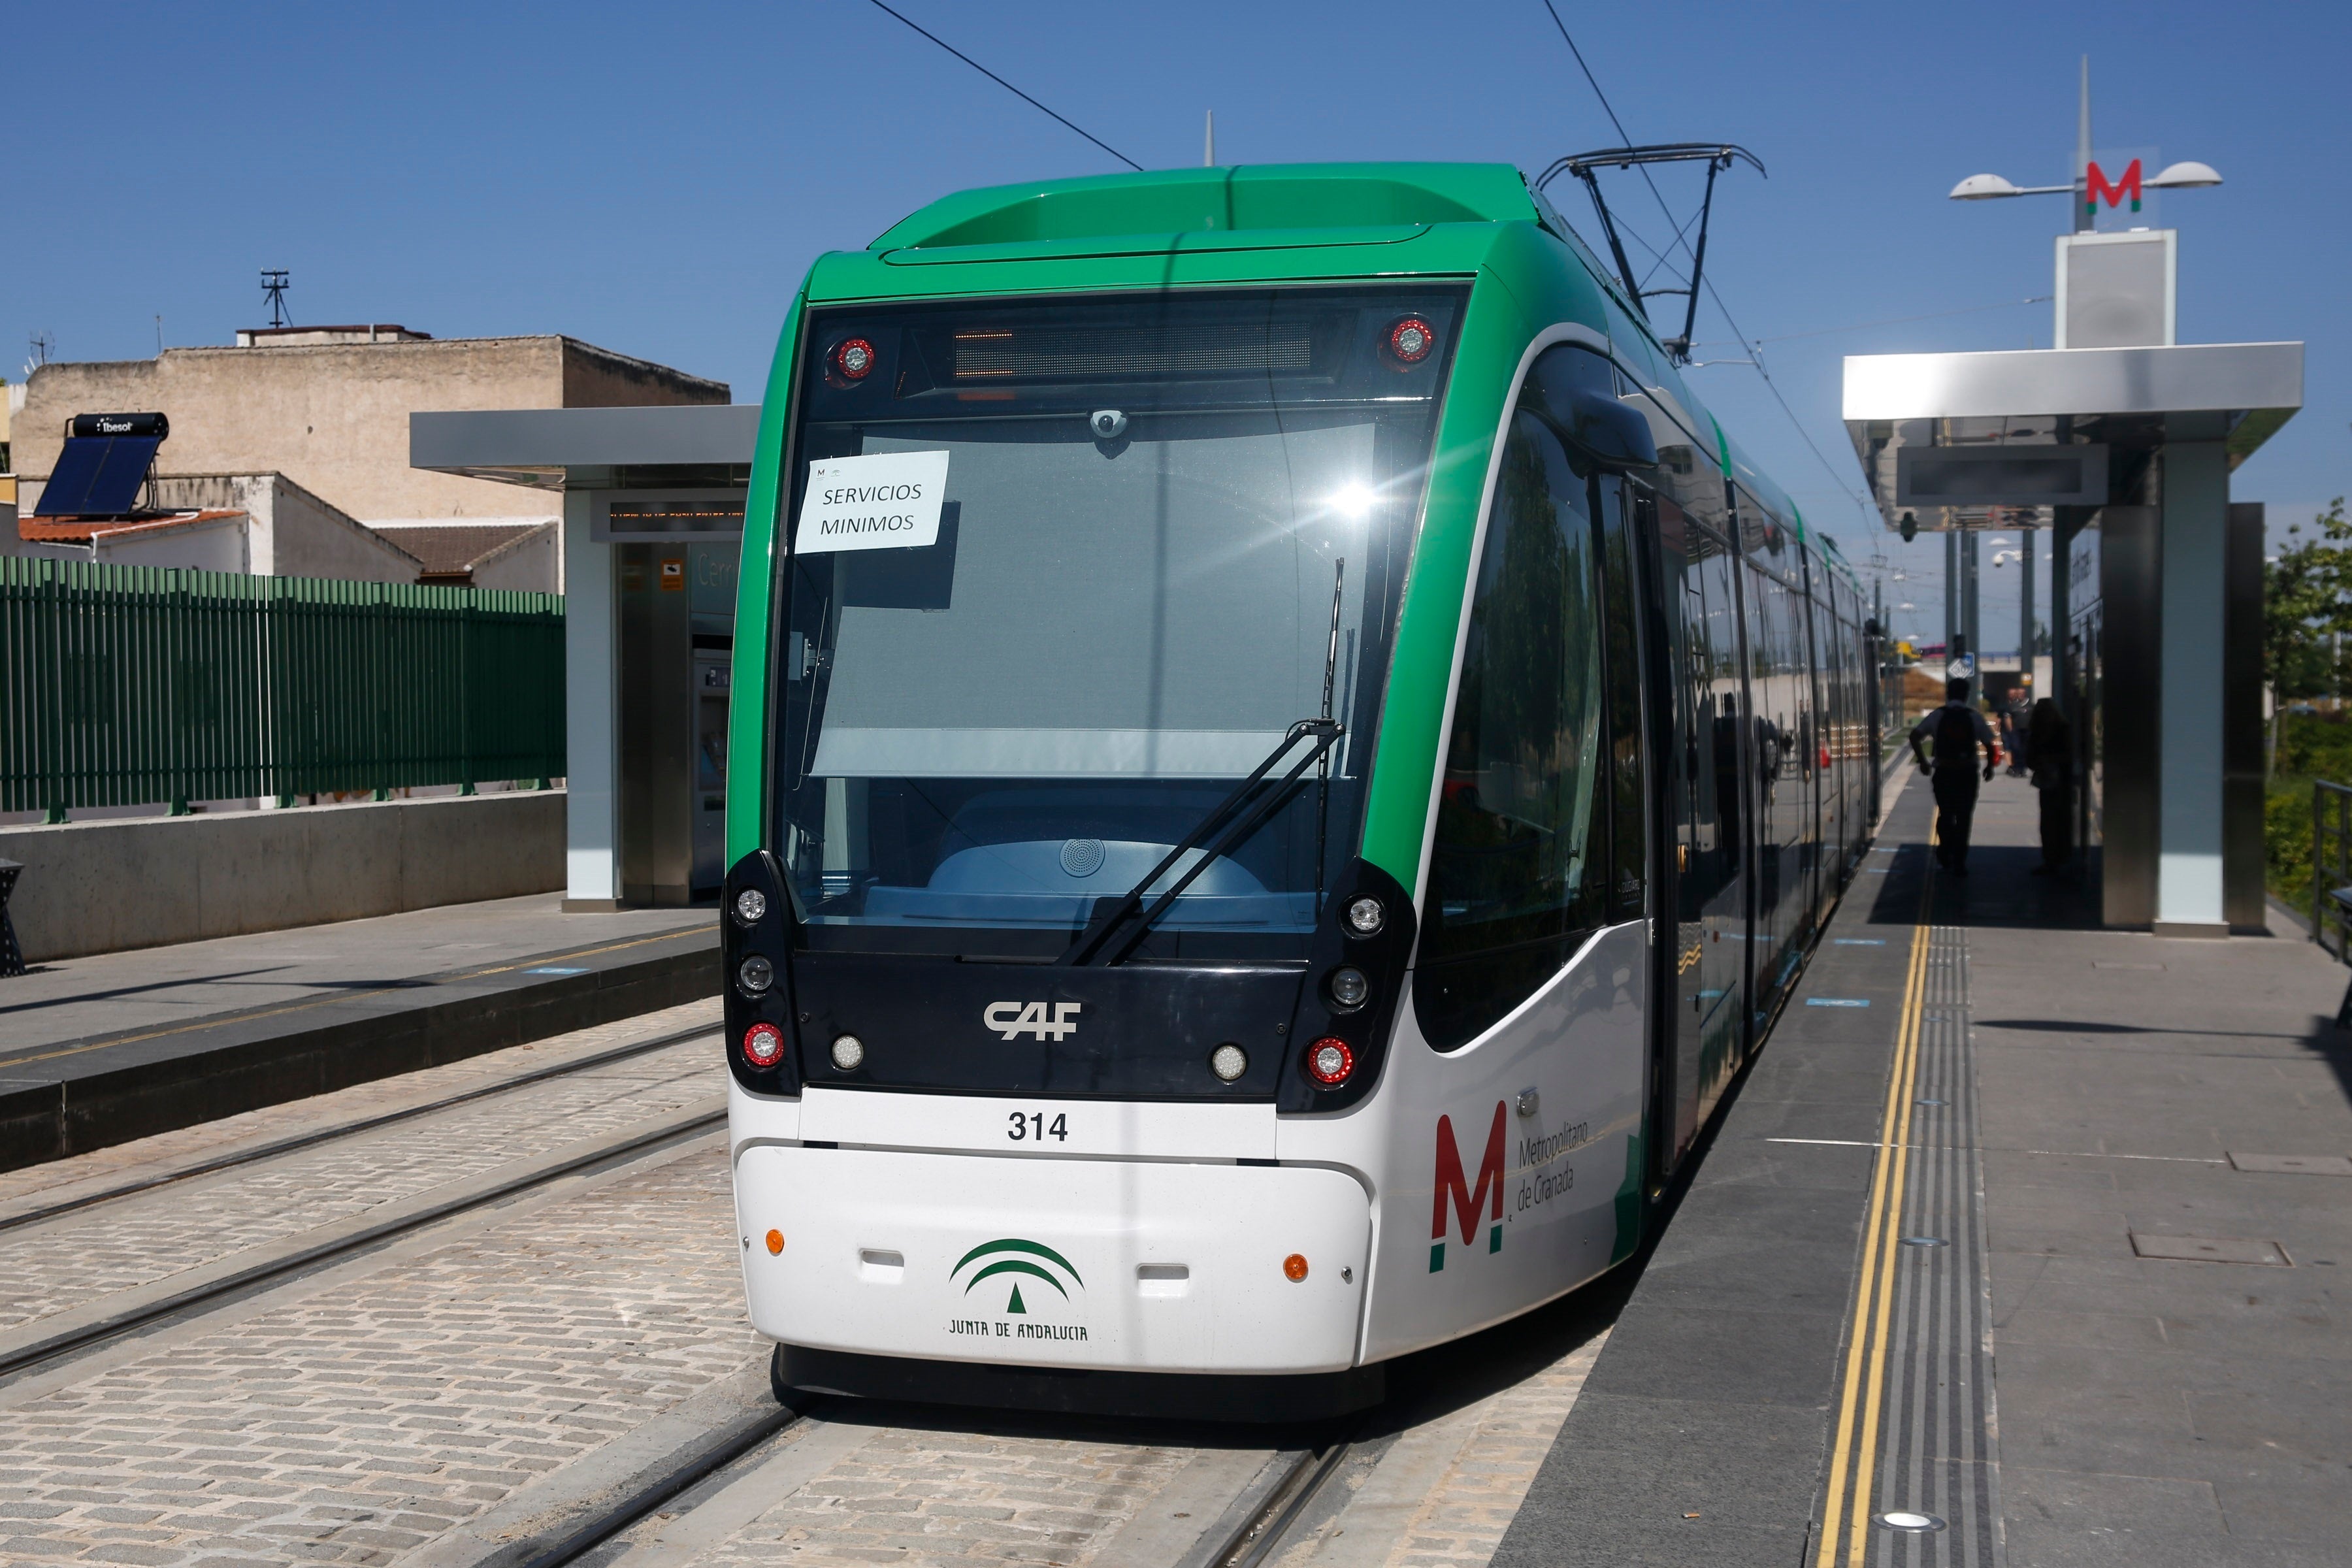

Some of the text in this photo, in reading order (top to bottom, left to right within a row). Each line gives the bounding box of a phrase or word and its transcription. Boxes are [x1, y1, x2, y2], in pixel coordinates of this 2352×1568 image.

[2086, 158, 2142, 215] M
[103, 422, 131, 433] Ibesol
[823, 483, 922, 505] SERVICIOS
[821, 515, 914, 535] MINIMOS
[983, 1001, 1081, 1041] CAF
[1007, 1112, 1068, 1141] 314
[1519, 1121, 1588, 1169] Metropolitano
[1429, 1100, 1507, 1273] M
[1518, 1160, 1573, 1212] de Granada
[949, 1320, 1088, 1341] JUNTA DE ANDALUCIA
